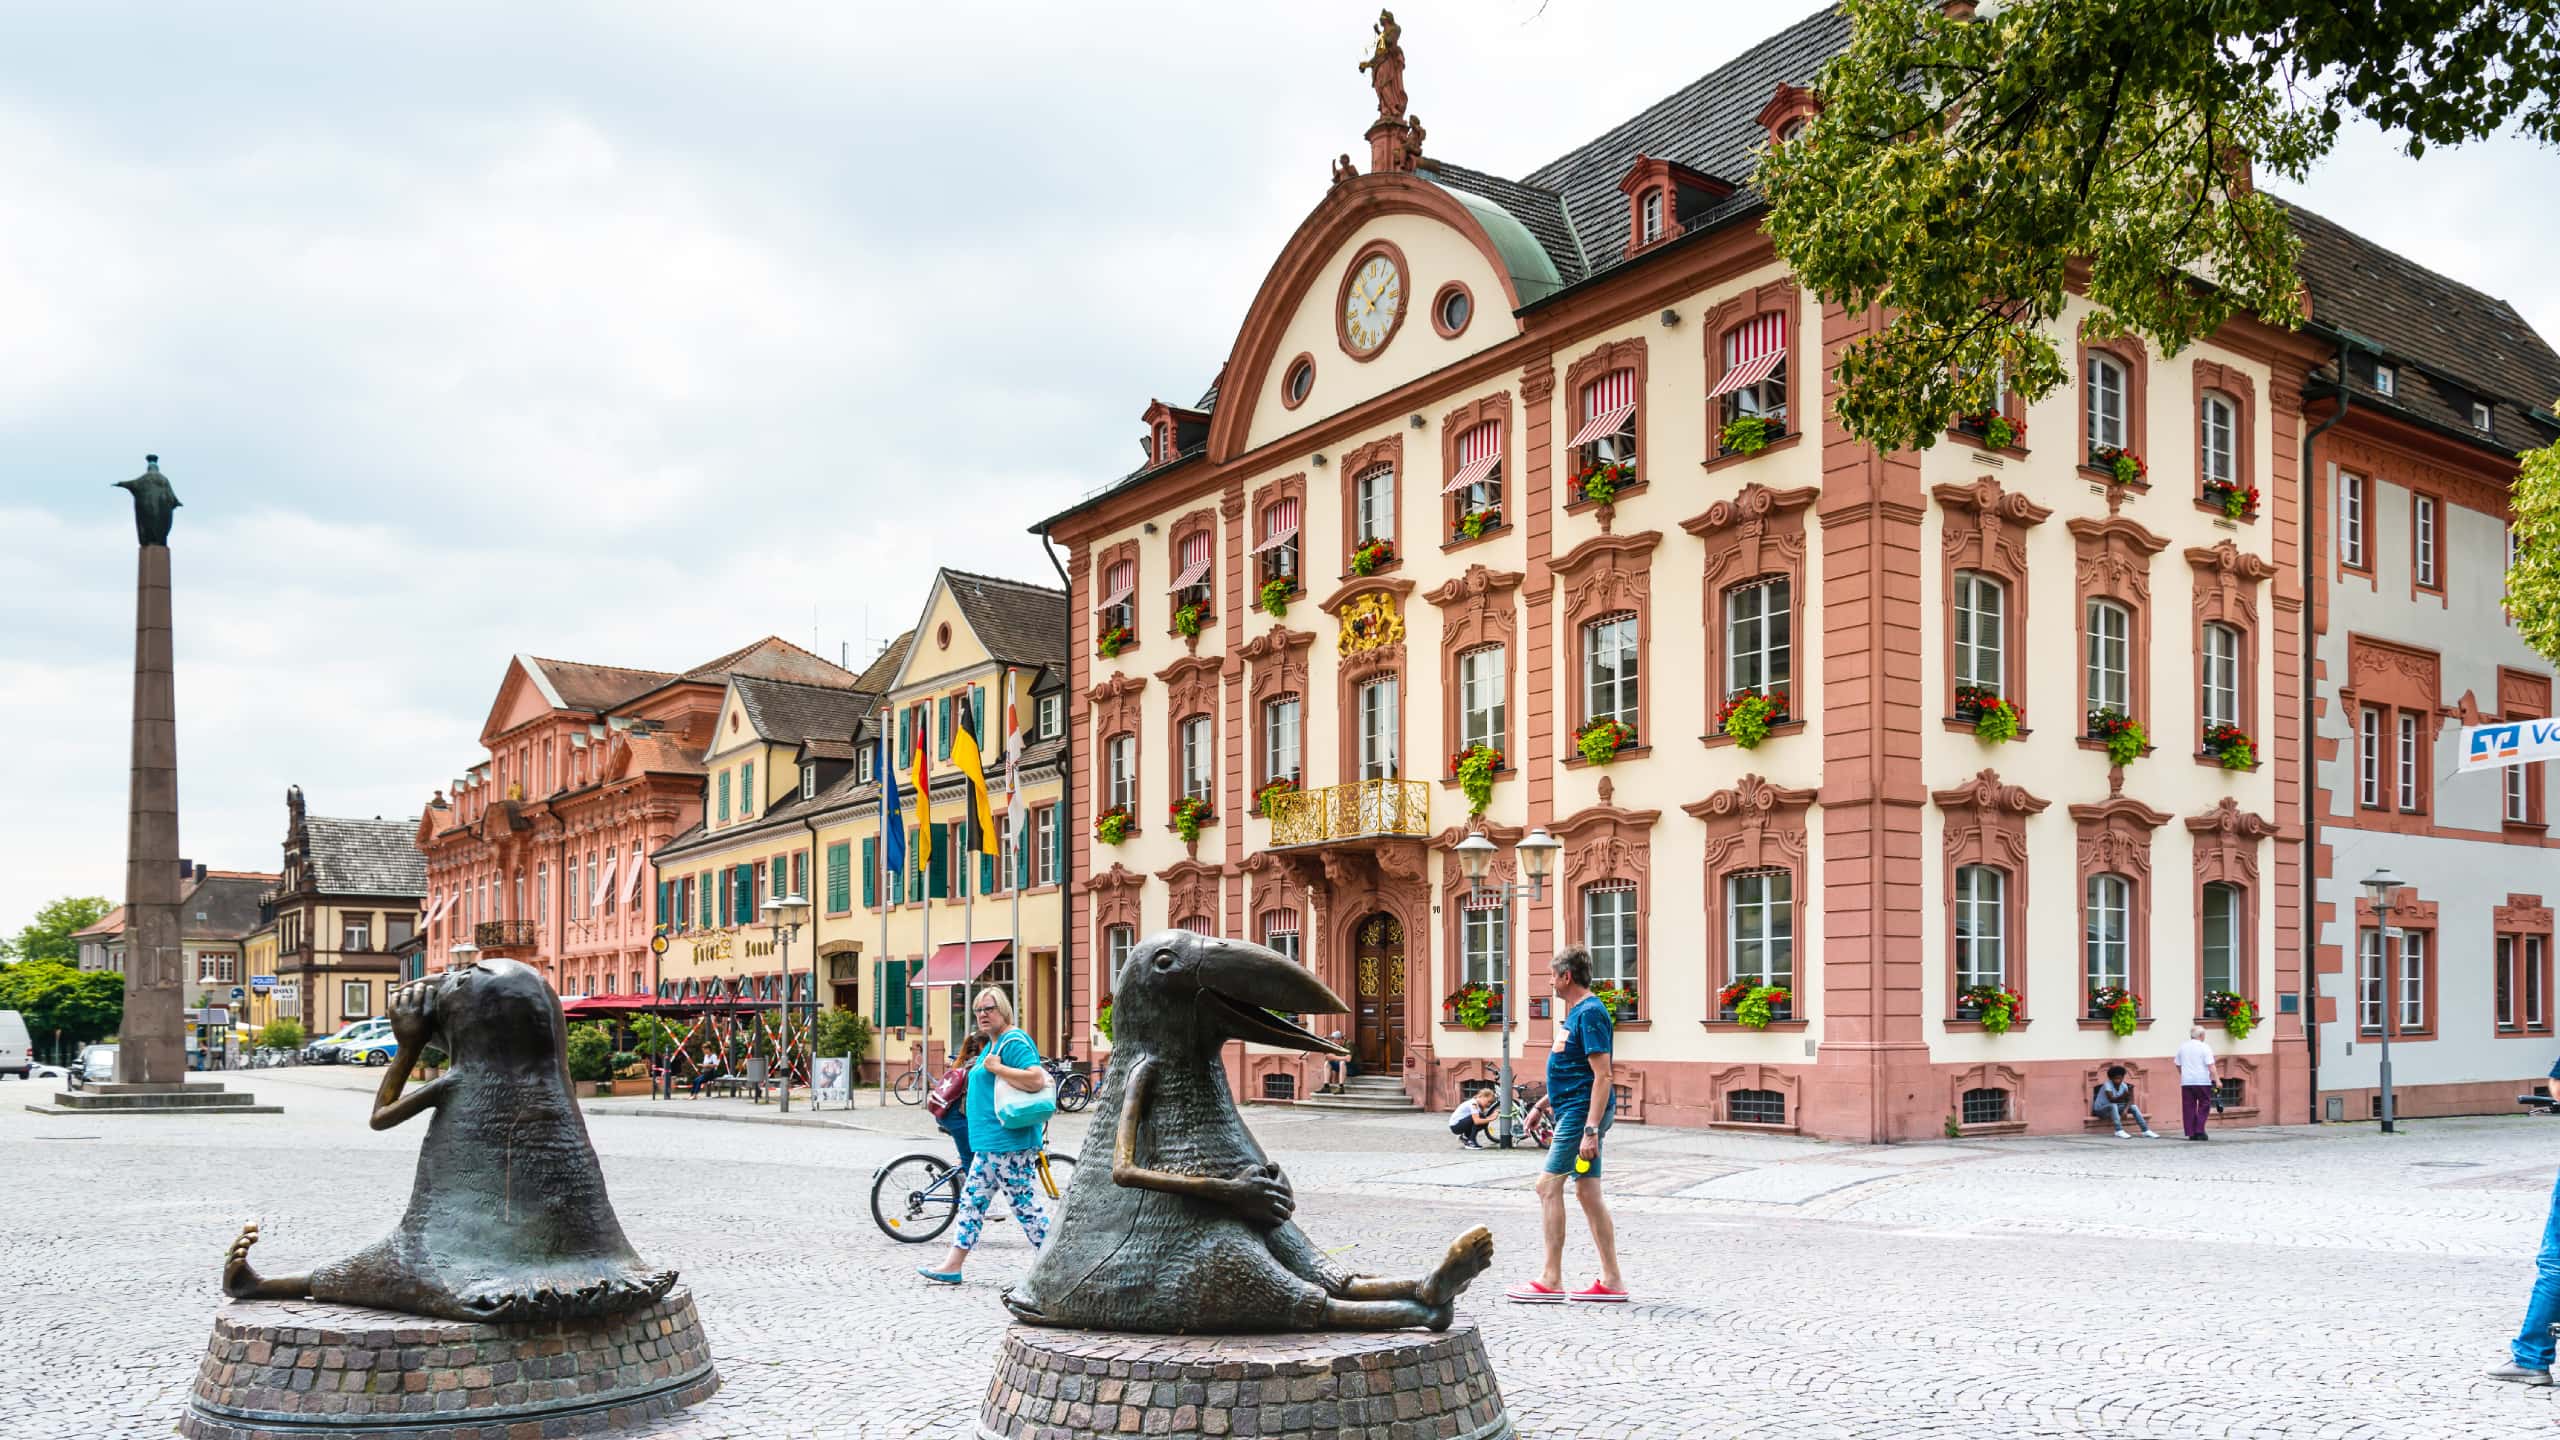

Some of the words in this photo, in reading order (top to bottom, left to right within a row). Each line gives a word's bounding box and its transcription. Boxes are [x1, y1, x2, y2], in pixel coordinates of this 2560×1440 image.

[1432, 905, 1441, 914] 90
[745, 940, 775, 958] Sonne
[252, 977, 276, 985] POLIZEI
